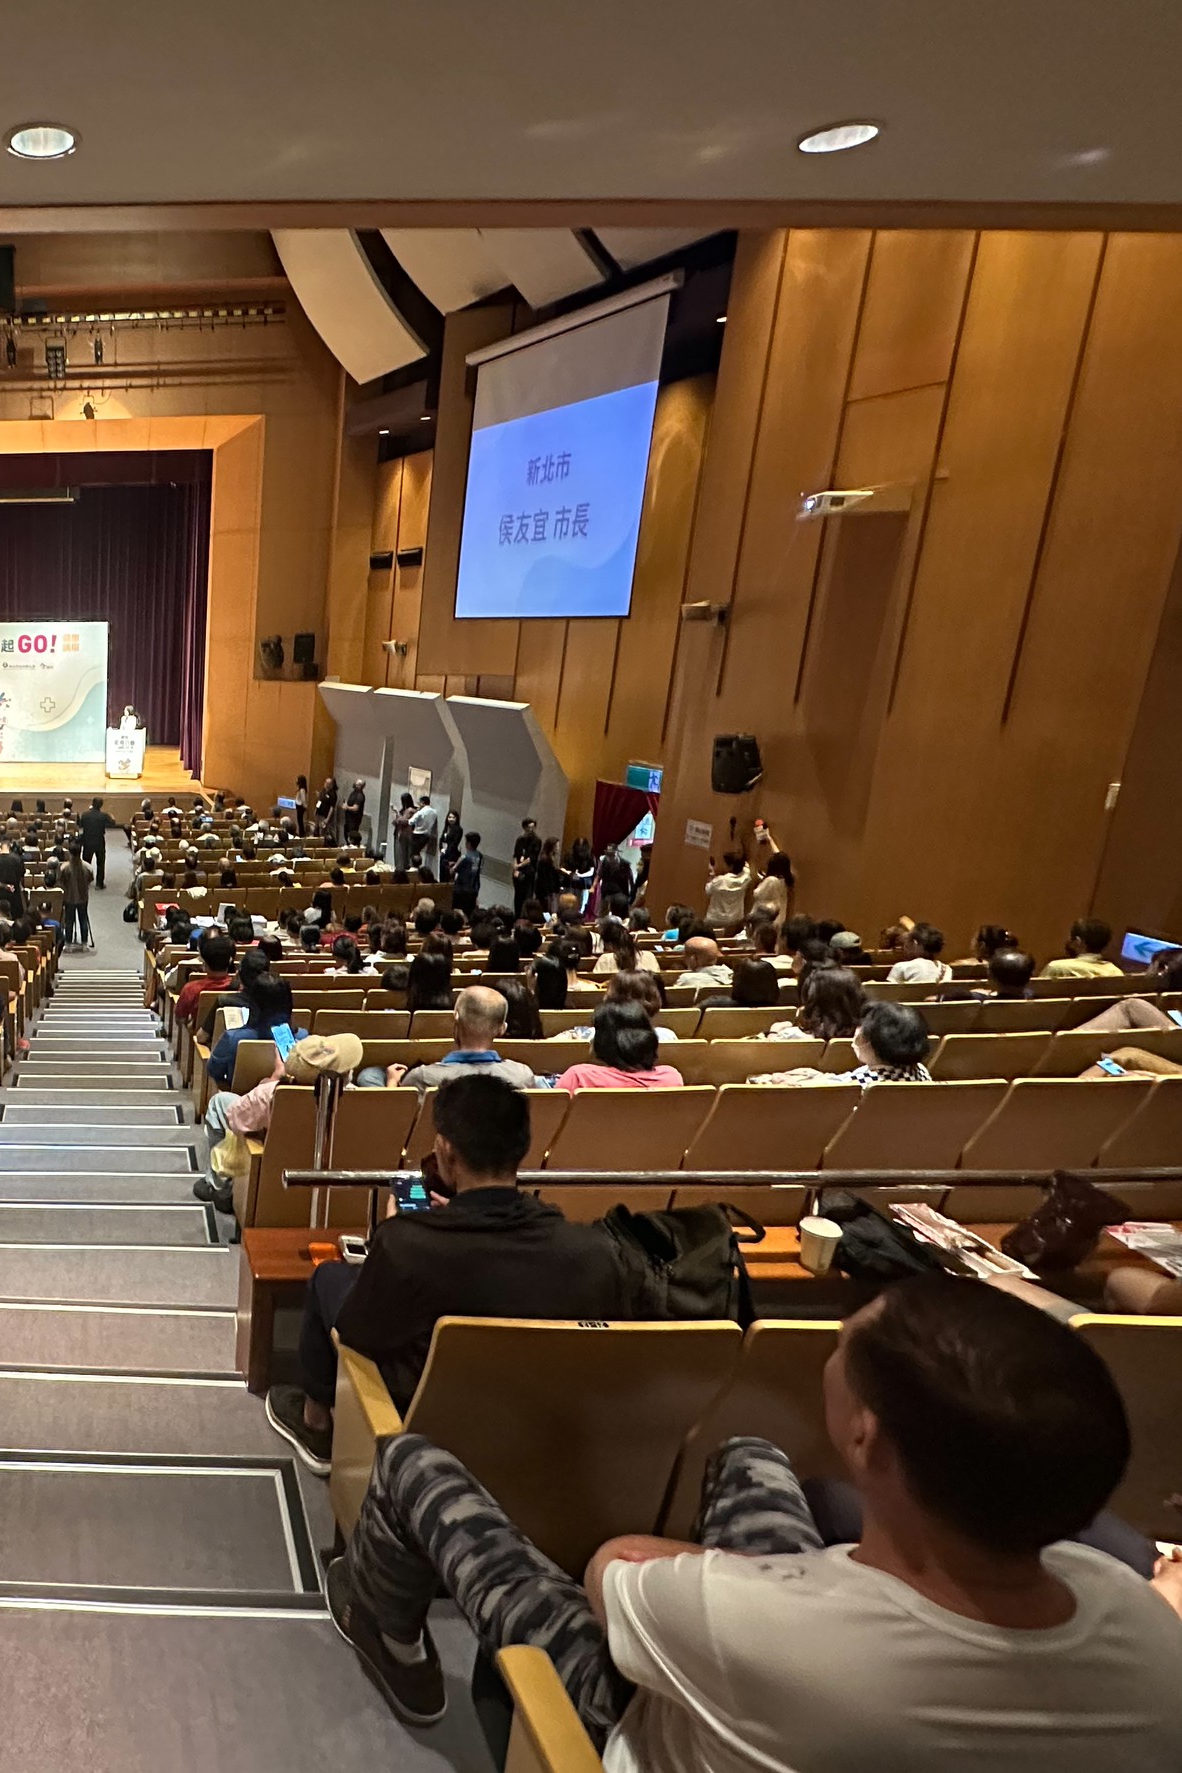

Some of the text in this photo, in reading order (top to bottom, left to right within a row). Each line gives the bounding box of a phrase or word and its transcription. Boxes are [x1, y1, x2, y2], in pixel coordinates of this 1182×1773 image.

[526, 450, 572, 486] 新北市
[498, 502, 590, 547] 侯友宜 市長
